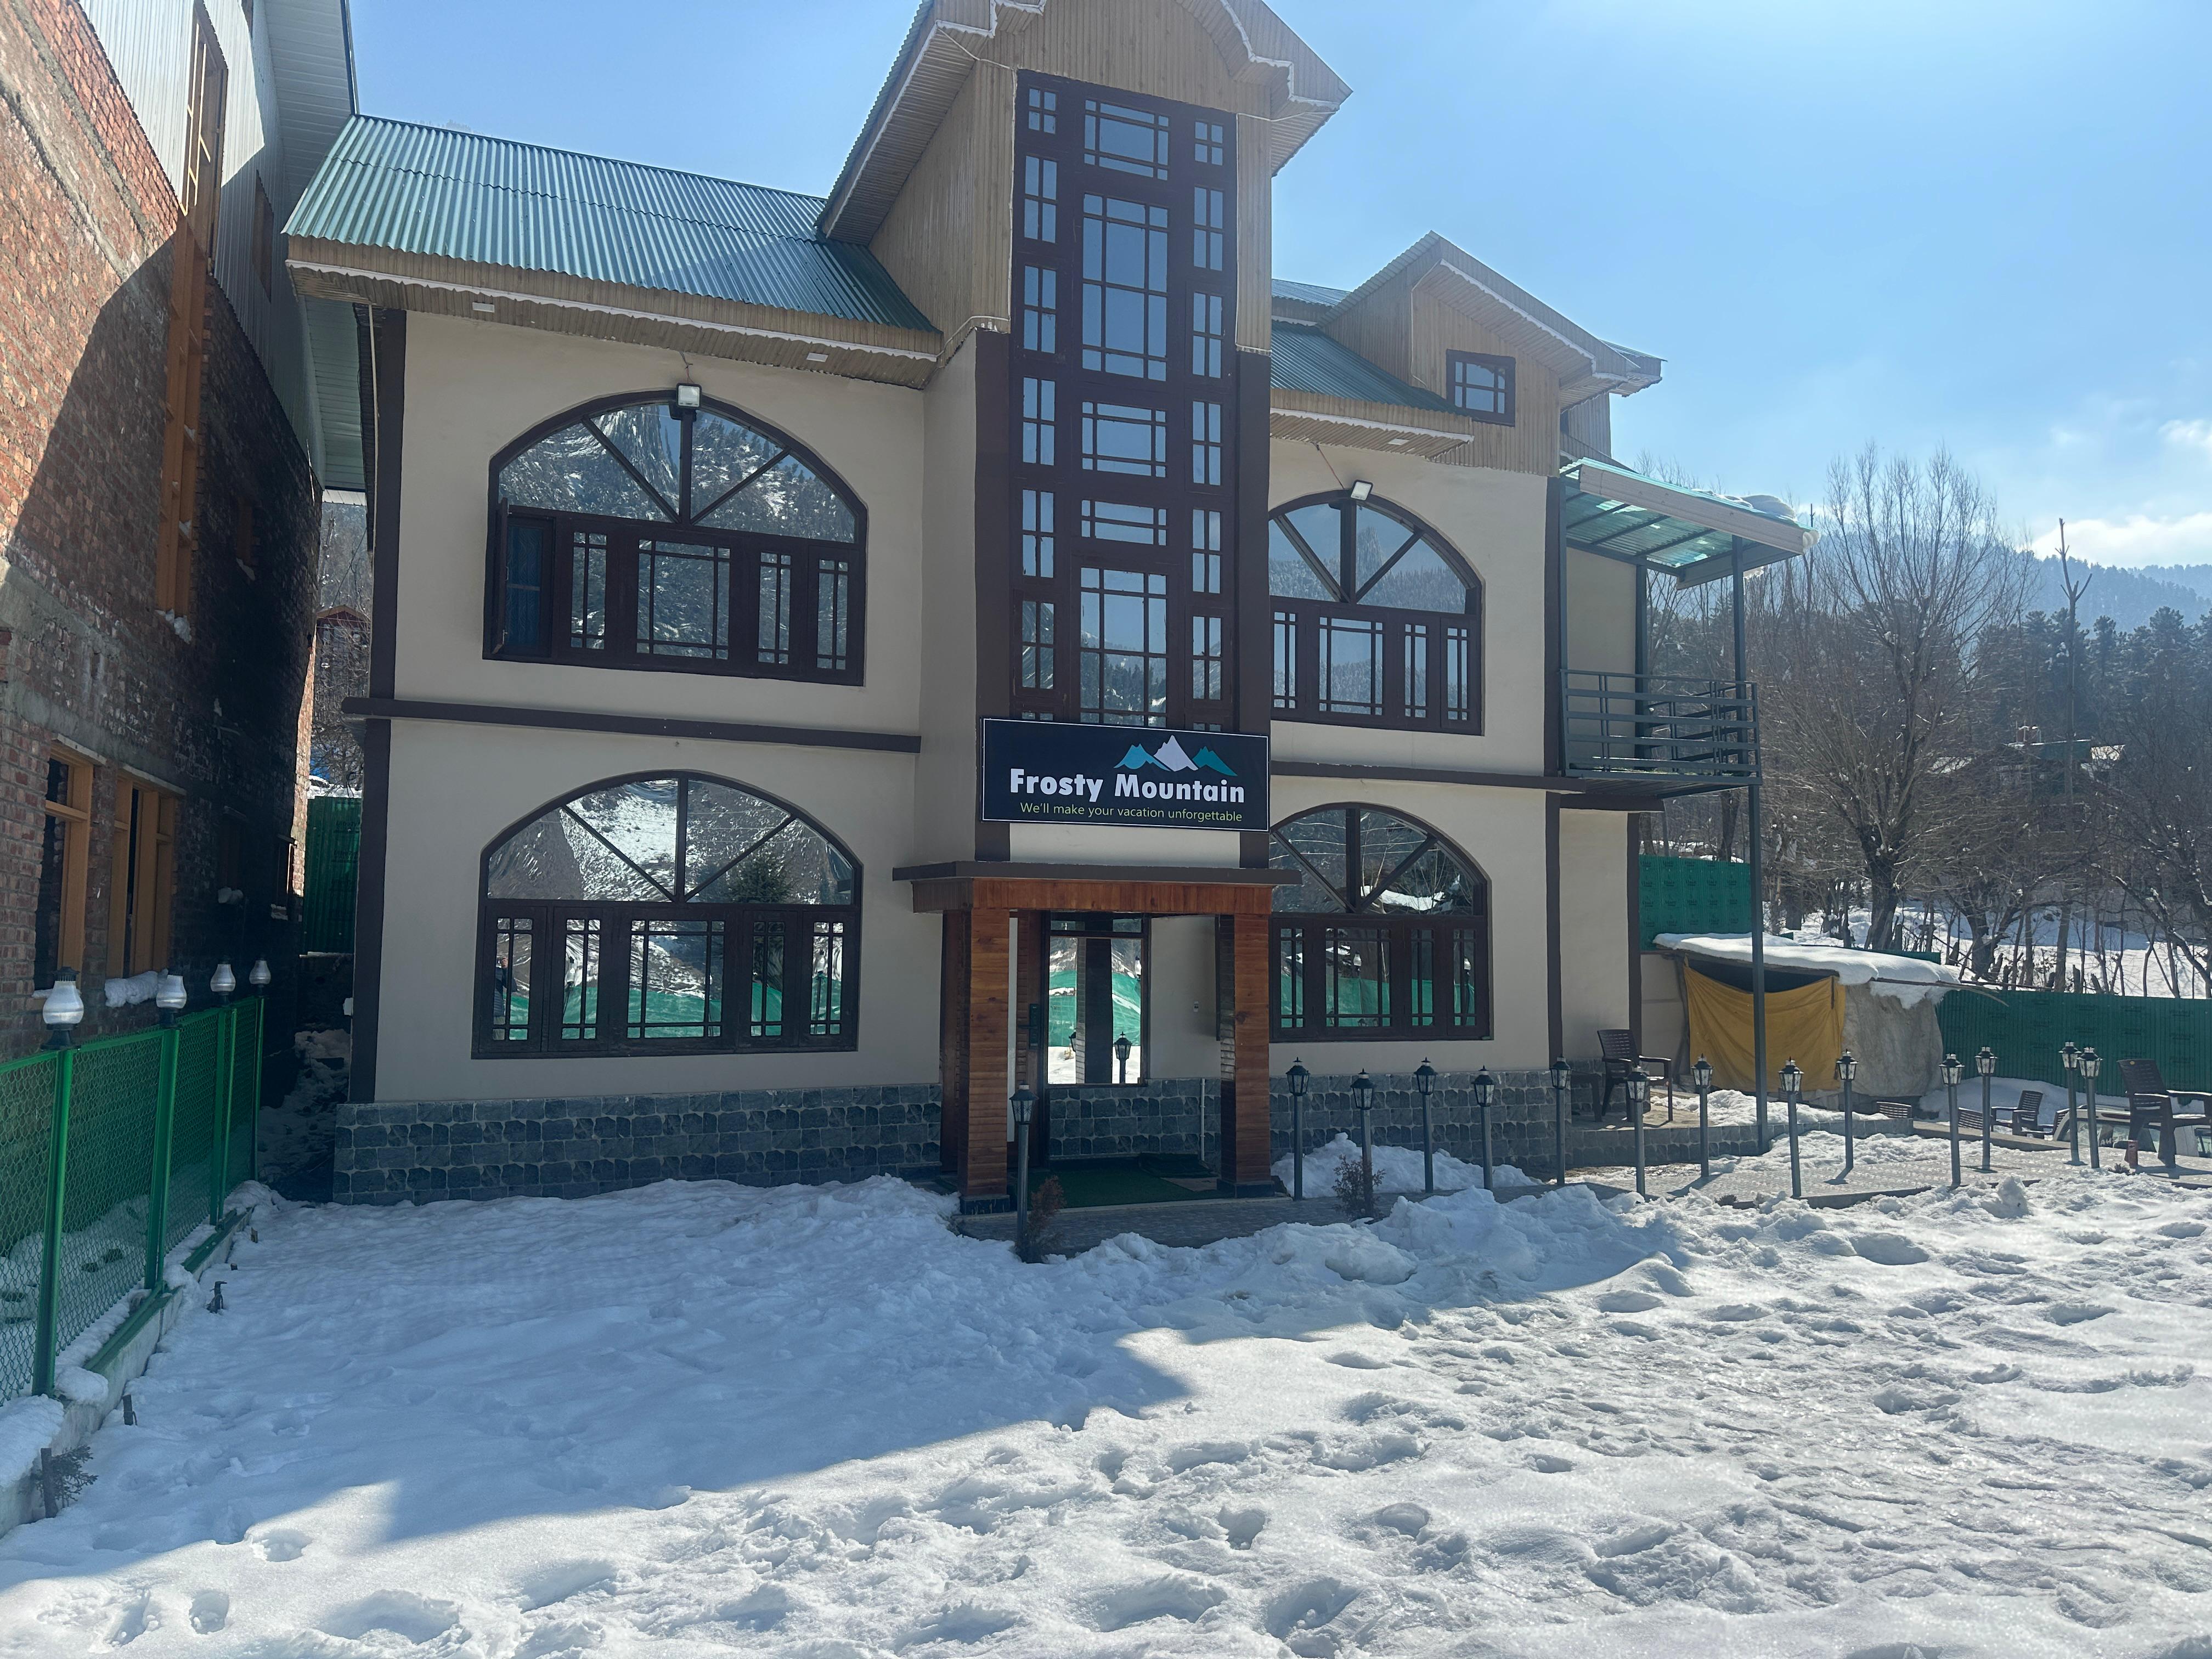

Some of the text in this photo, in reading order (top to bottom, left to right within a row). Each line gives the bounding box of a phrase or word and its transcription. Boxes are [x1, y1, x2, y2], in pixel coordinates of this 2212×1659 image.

[1011, 768, 1244, 803] Frosty Mountain
[1020, 802, 1242, 822] We'll make your vacation unforgettable
